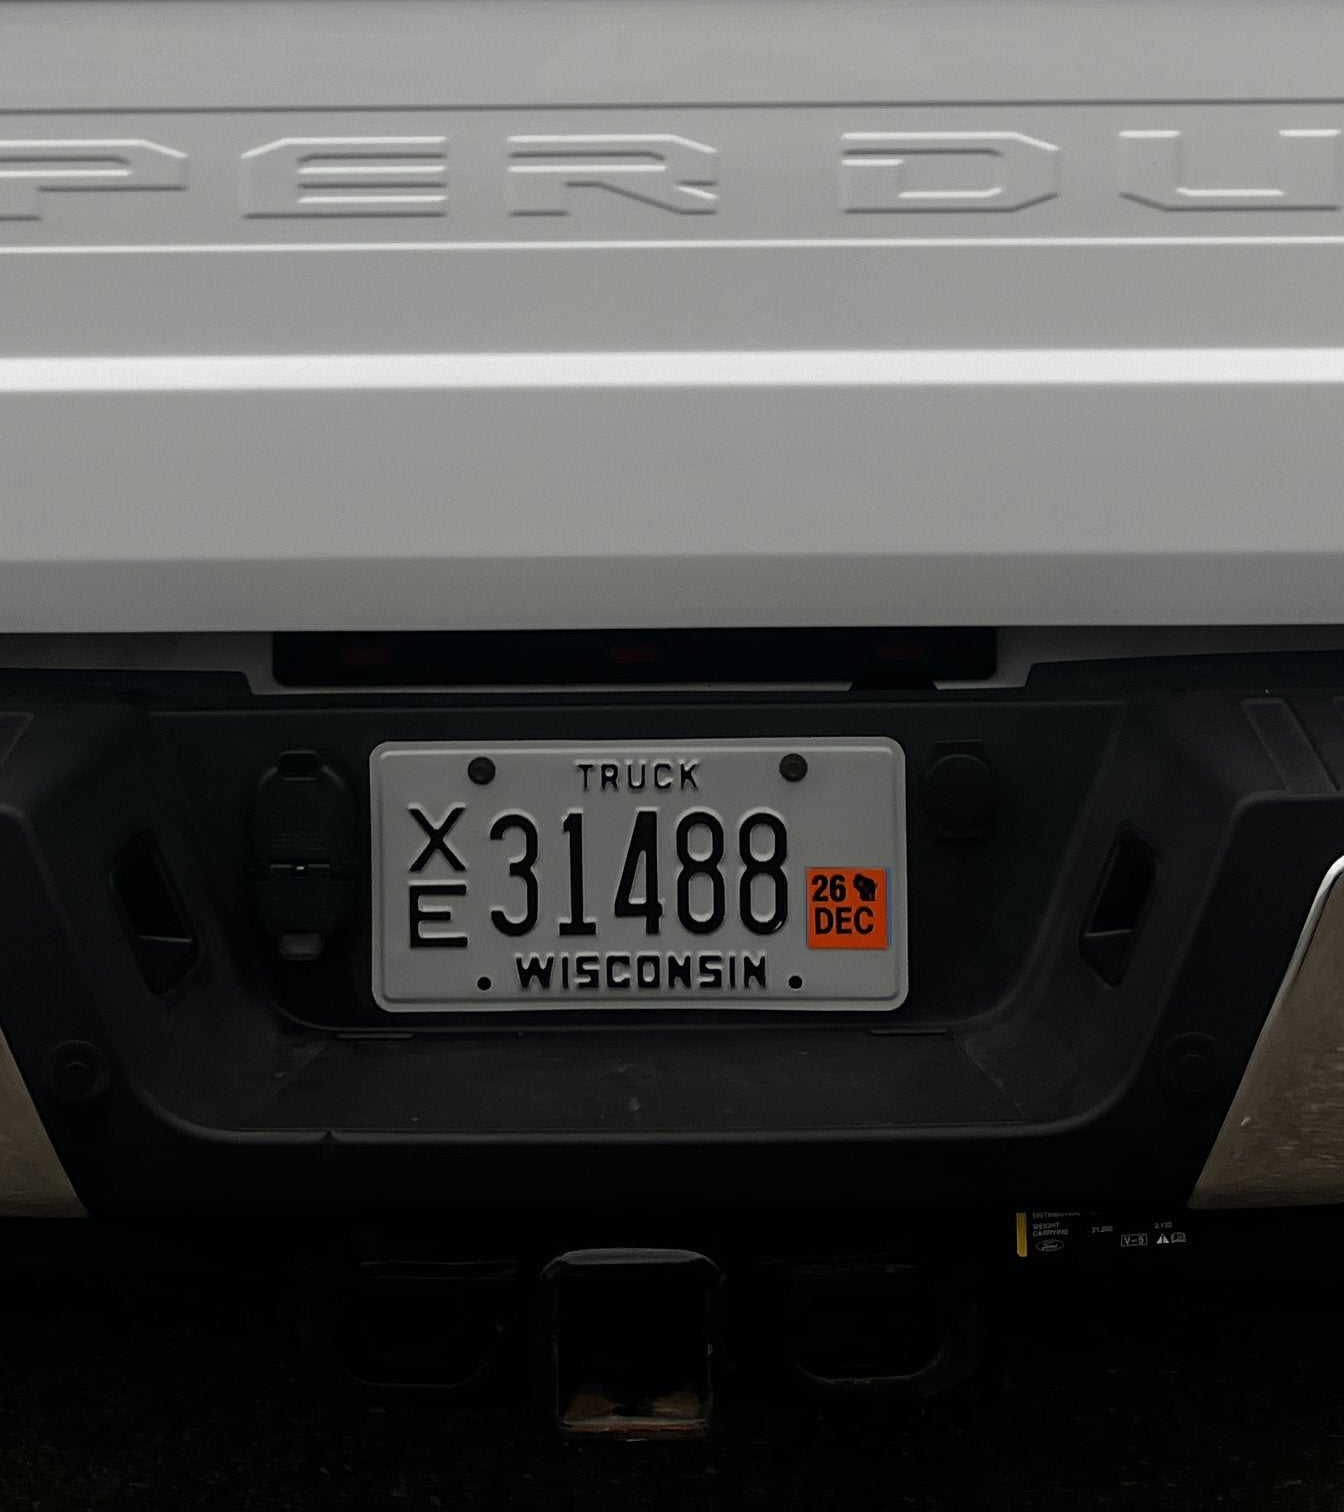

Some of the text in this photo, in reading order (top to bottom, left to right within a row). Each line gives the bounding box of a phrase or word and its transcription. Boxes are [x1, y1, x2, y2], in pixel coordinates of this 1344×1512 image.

[577, 762, 700, 790] TRUCK
[489, 810, 789, 937] 31488
[811, 875, 847, 902] 26
[814, 906, 875, 935] DEC
[516, 954, 767, 990] WISCONSIN
